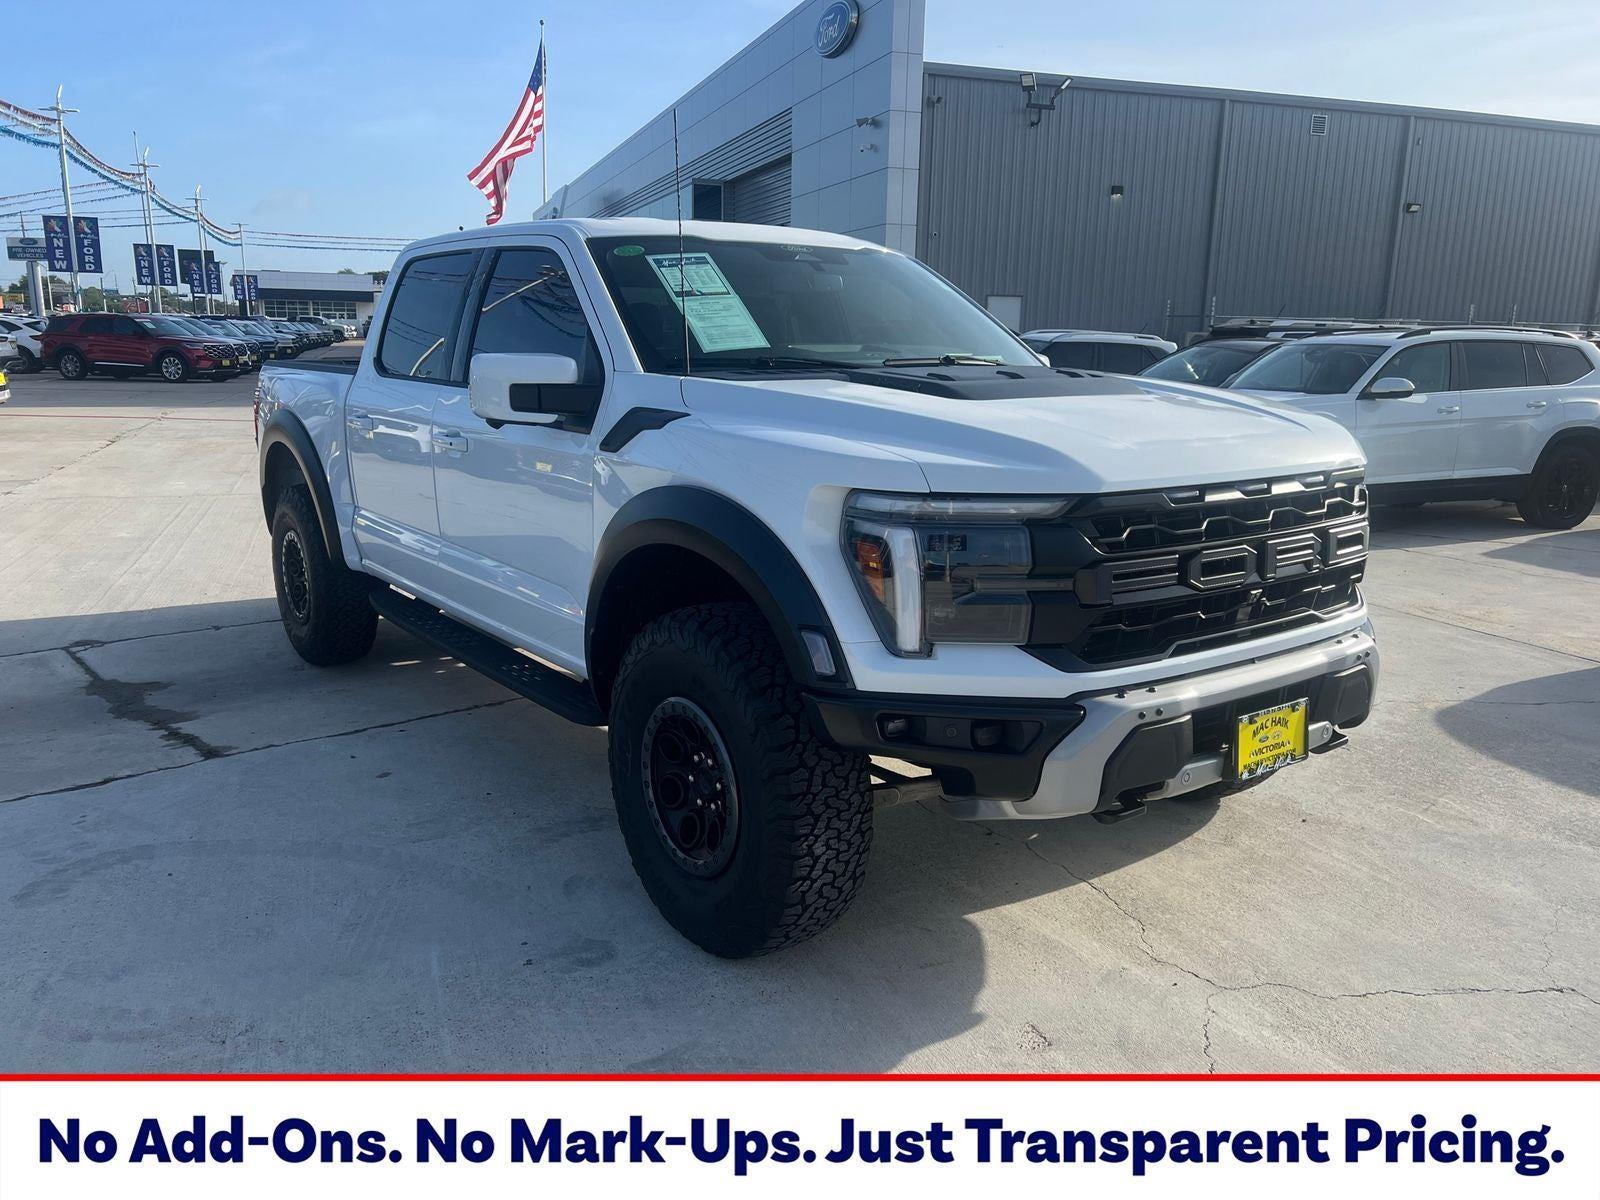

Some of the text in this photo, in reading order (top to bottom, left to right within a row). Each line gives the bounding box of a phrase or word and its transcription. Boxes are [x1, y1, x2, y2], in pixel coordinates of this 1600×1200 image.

[818, 12, 840, 47] Ford
[53, 238, 67, 270] NEW
[83, 238, 95, 271] FORD
[141, 260, 151, 284] NEW
[163, 260, 172, 285] FORD
[192, 273, 201, 293] NEW
[210, 274, 218, 293] FORD
[1076, 519, 1369, 606] FORD
[1252, 716, 1290, 740] MAC HAIK
